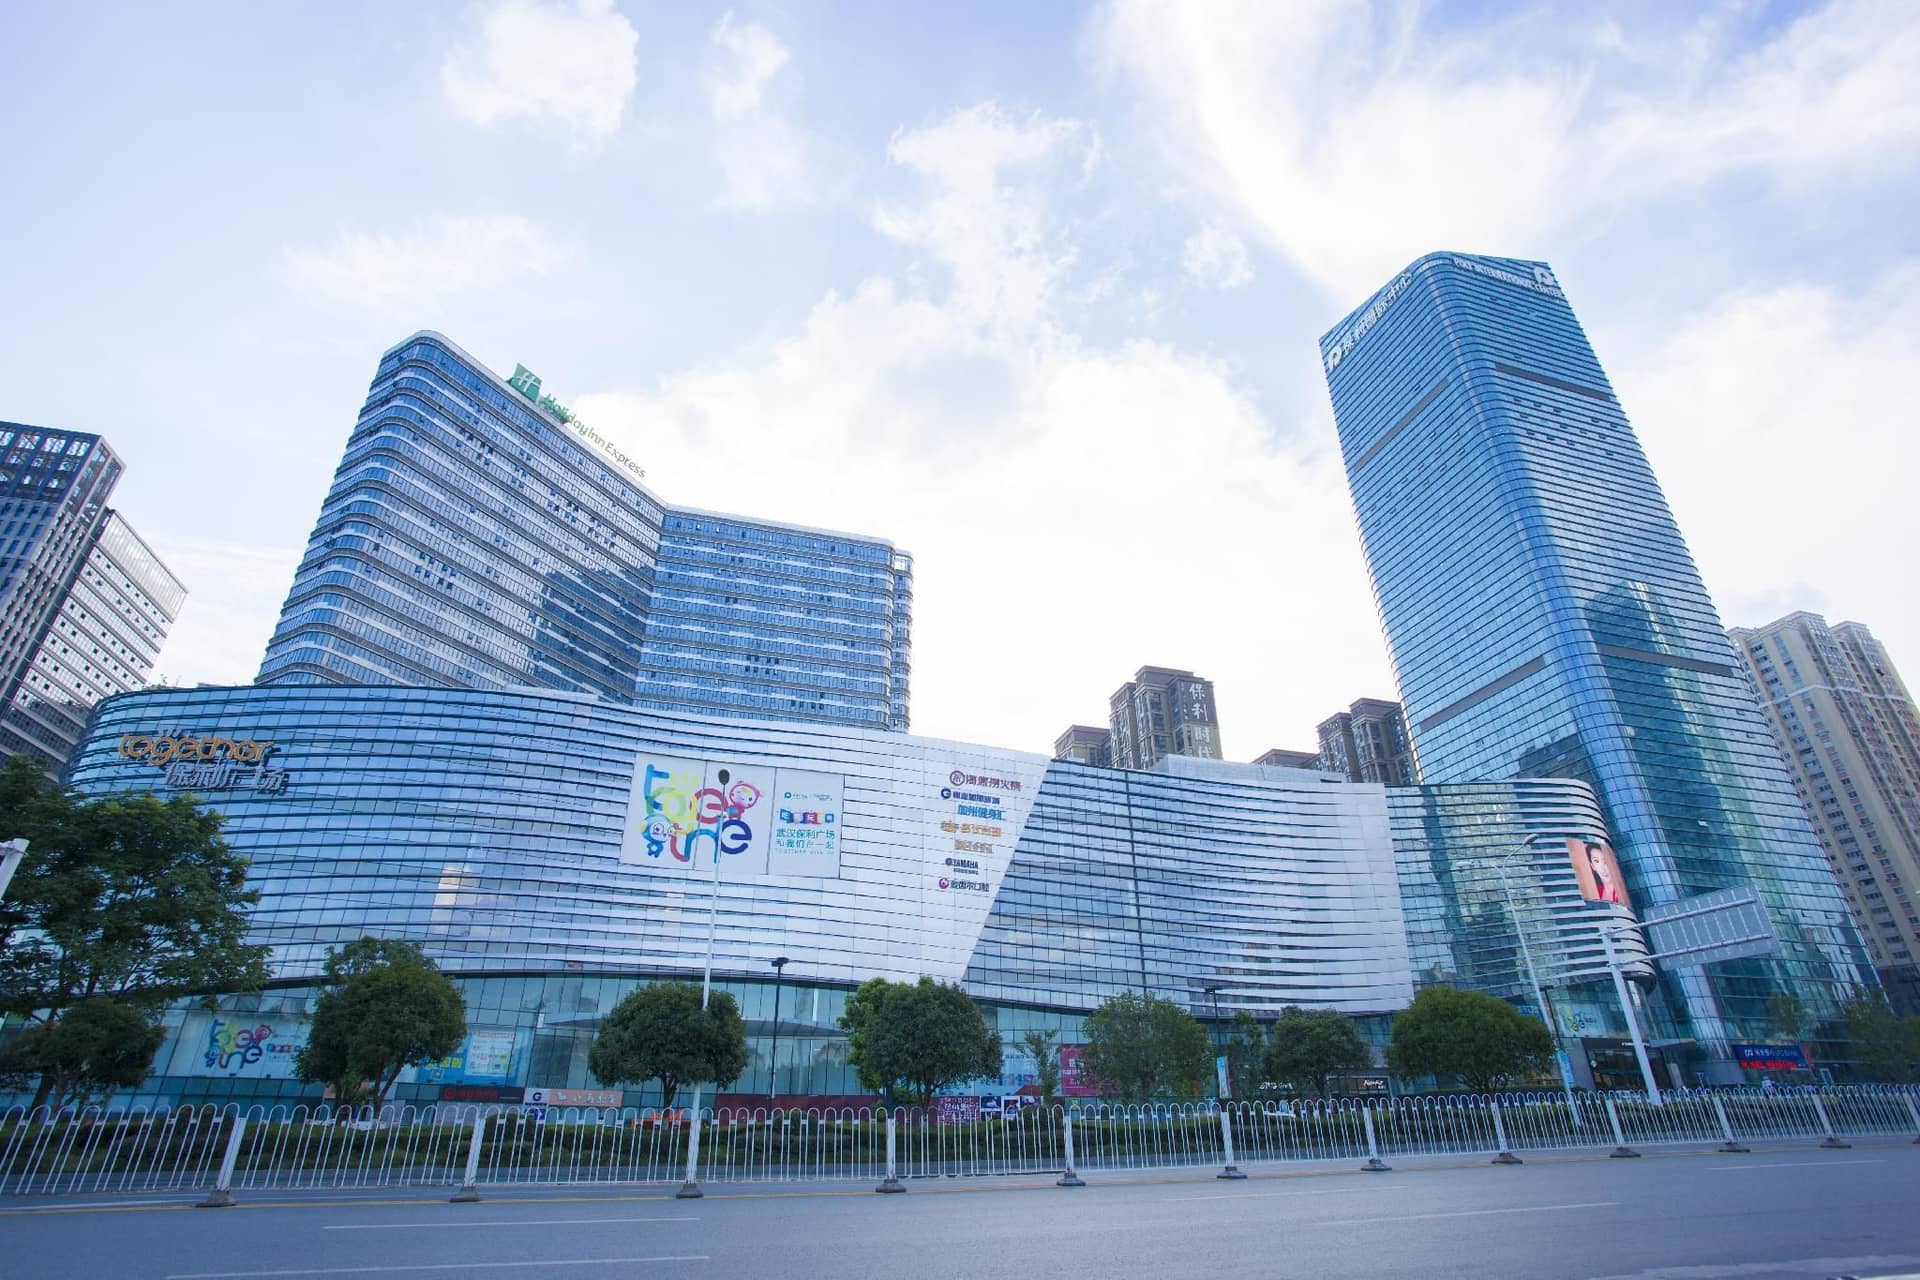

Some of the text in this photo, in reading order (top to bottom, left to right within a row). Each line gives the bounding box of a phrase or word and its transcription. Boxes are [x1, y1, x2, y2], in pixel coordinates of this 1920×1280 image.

[542, 392, 646, 479] Holiday Inn Express
[776, 828, 835, 839] 武汉保利广场
